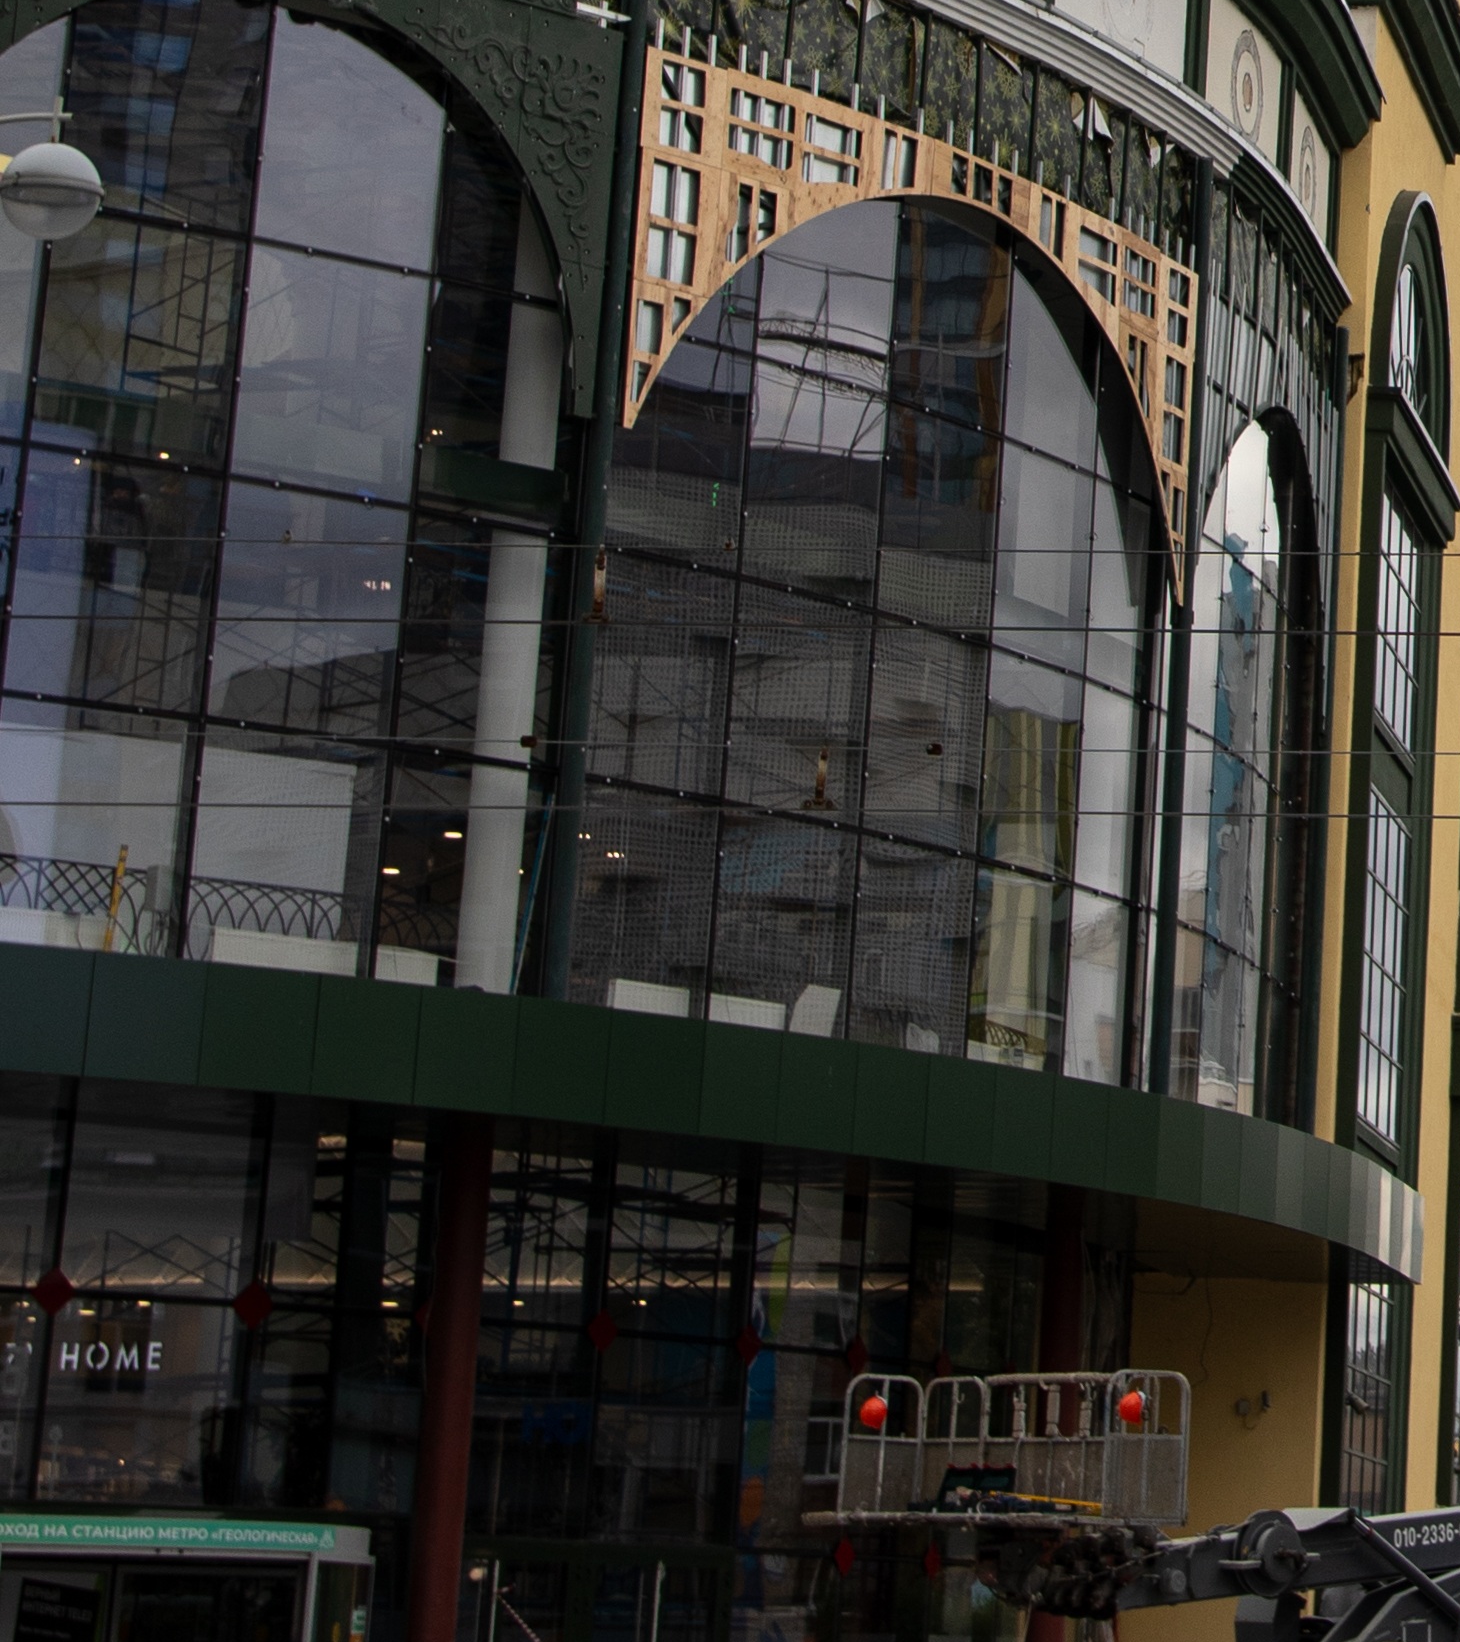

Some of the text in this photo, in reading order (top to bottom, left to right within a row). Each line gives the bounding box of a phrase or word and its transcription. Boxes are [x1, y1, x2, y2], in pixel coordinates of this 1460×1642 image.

[60, 1340, 163, 1371] HOME
[44, 1524, 68, 1537] НА
[72, 1524, 155, 1541] СТАНЦИЮ
[158, 1526, 208, 1541] МЕТРО
